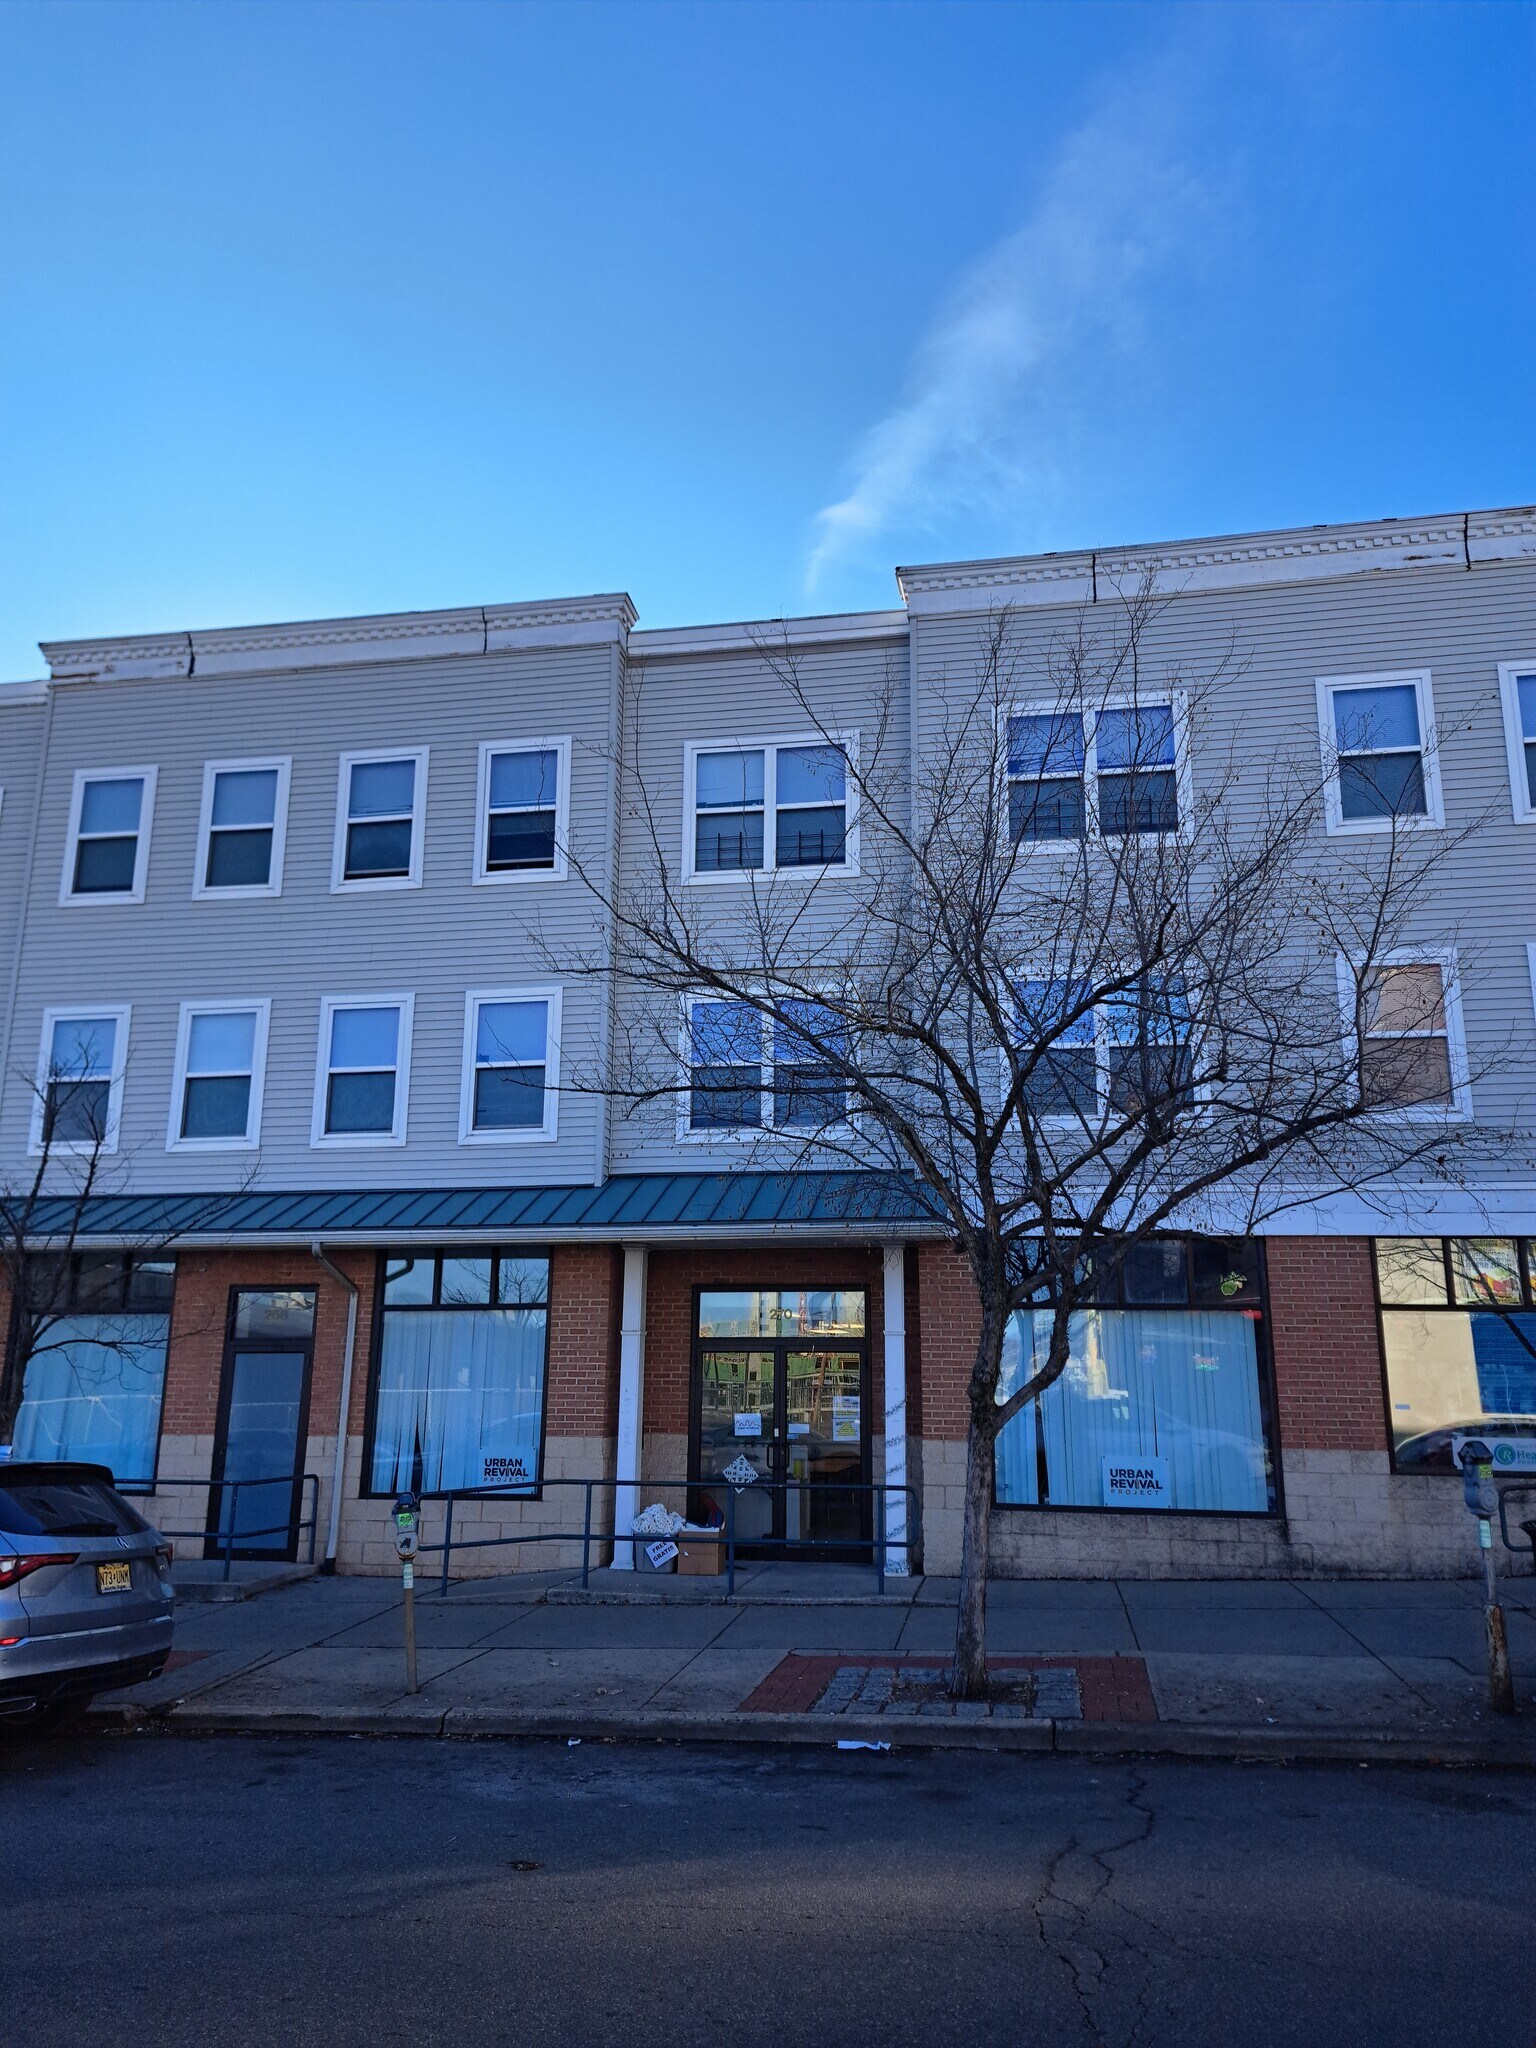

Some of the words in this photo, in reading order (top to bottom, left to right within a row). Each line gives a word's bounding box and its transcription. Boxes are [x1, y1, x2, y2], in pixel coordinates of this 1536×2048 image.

[769, 1308, 793, 1320] 270
[484, 1458, 523, 1467] URBAN
[484, 1468, 529, 1477] REVIVAL
[1109, 1468, 1154, 1479] URBAN
[1110, 1478, 1163, 1489] REVIVAL
[653, 1545, 675, 1562] GRATIS
